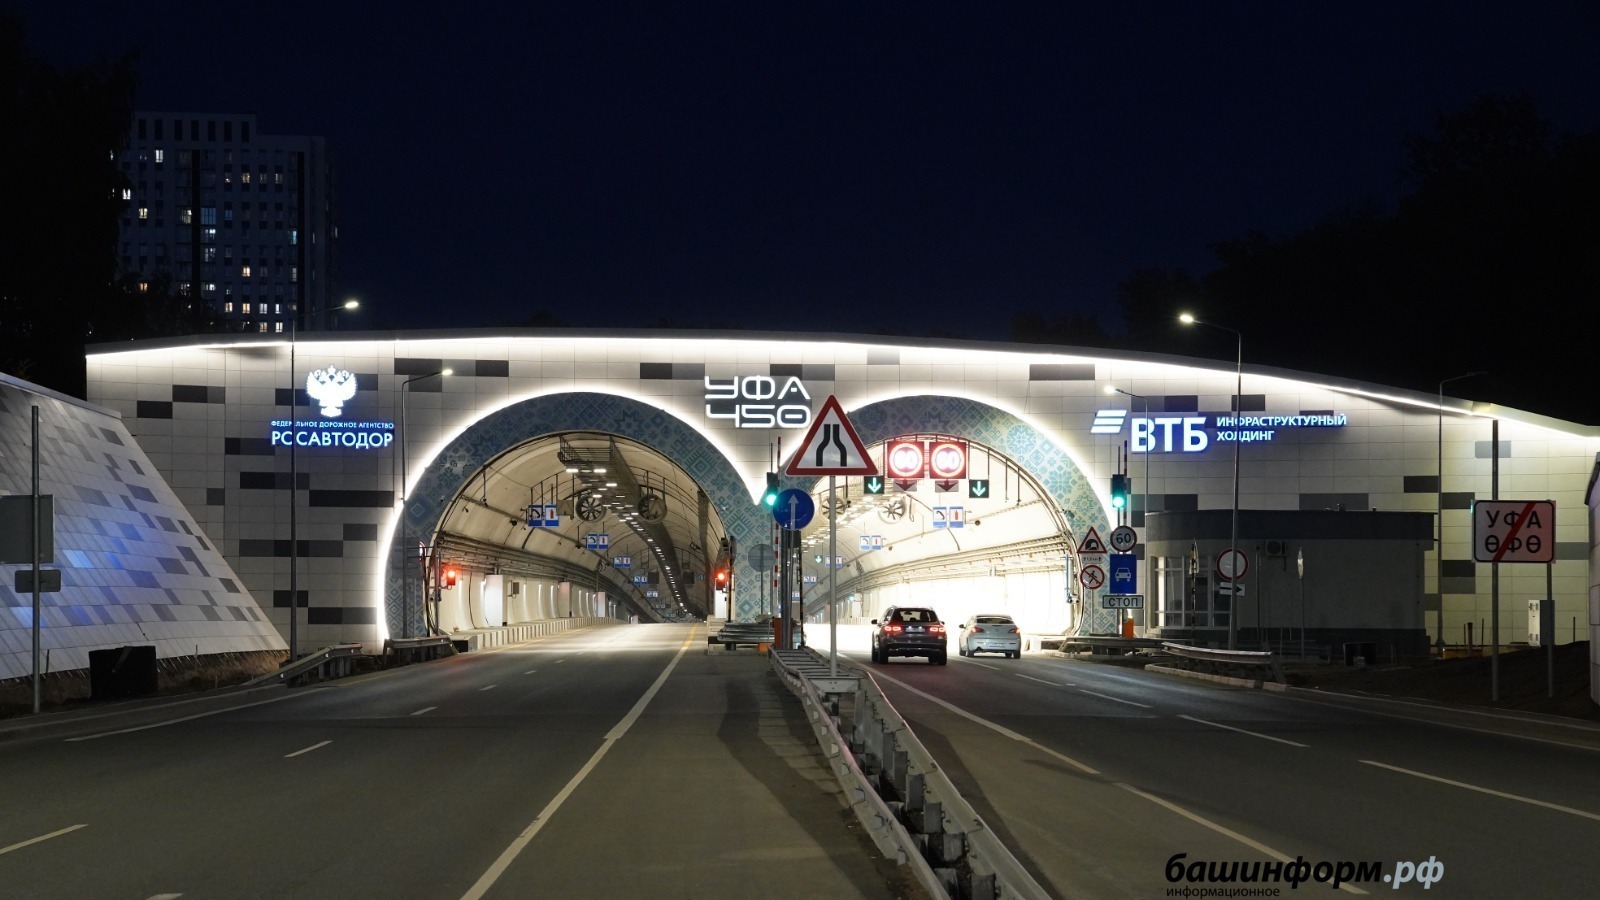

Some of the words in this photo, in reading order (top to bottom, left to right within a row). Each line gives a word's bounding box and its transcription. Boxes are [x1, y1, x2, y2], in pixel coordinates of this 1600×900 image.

[705, 375, 811, 400] УФА
[706, 403, 811, 428] 450
[1216, 413, 1347, 427] ИНФРАСТРУКТУРНЫЙ
[271, 420, 317, 428] ФЕДЕРЛЬНОЕ
[319, 421, 357, 429] ДОРОЖНОЕ
[1131, 417, 1208, 452] ВТБ
[1216, 430, 1275, 442] ХОЛДИНГ
[1486, 510, 1542, 528] УФА
[1116, 533, 1131, 544] 60
[1485, 535, 1542, 553] ӨФӨ
[1108, 597, 1138, 607] СТОП
